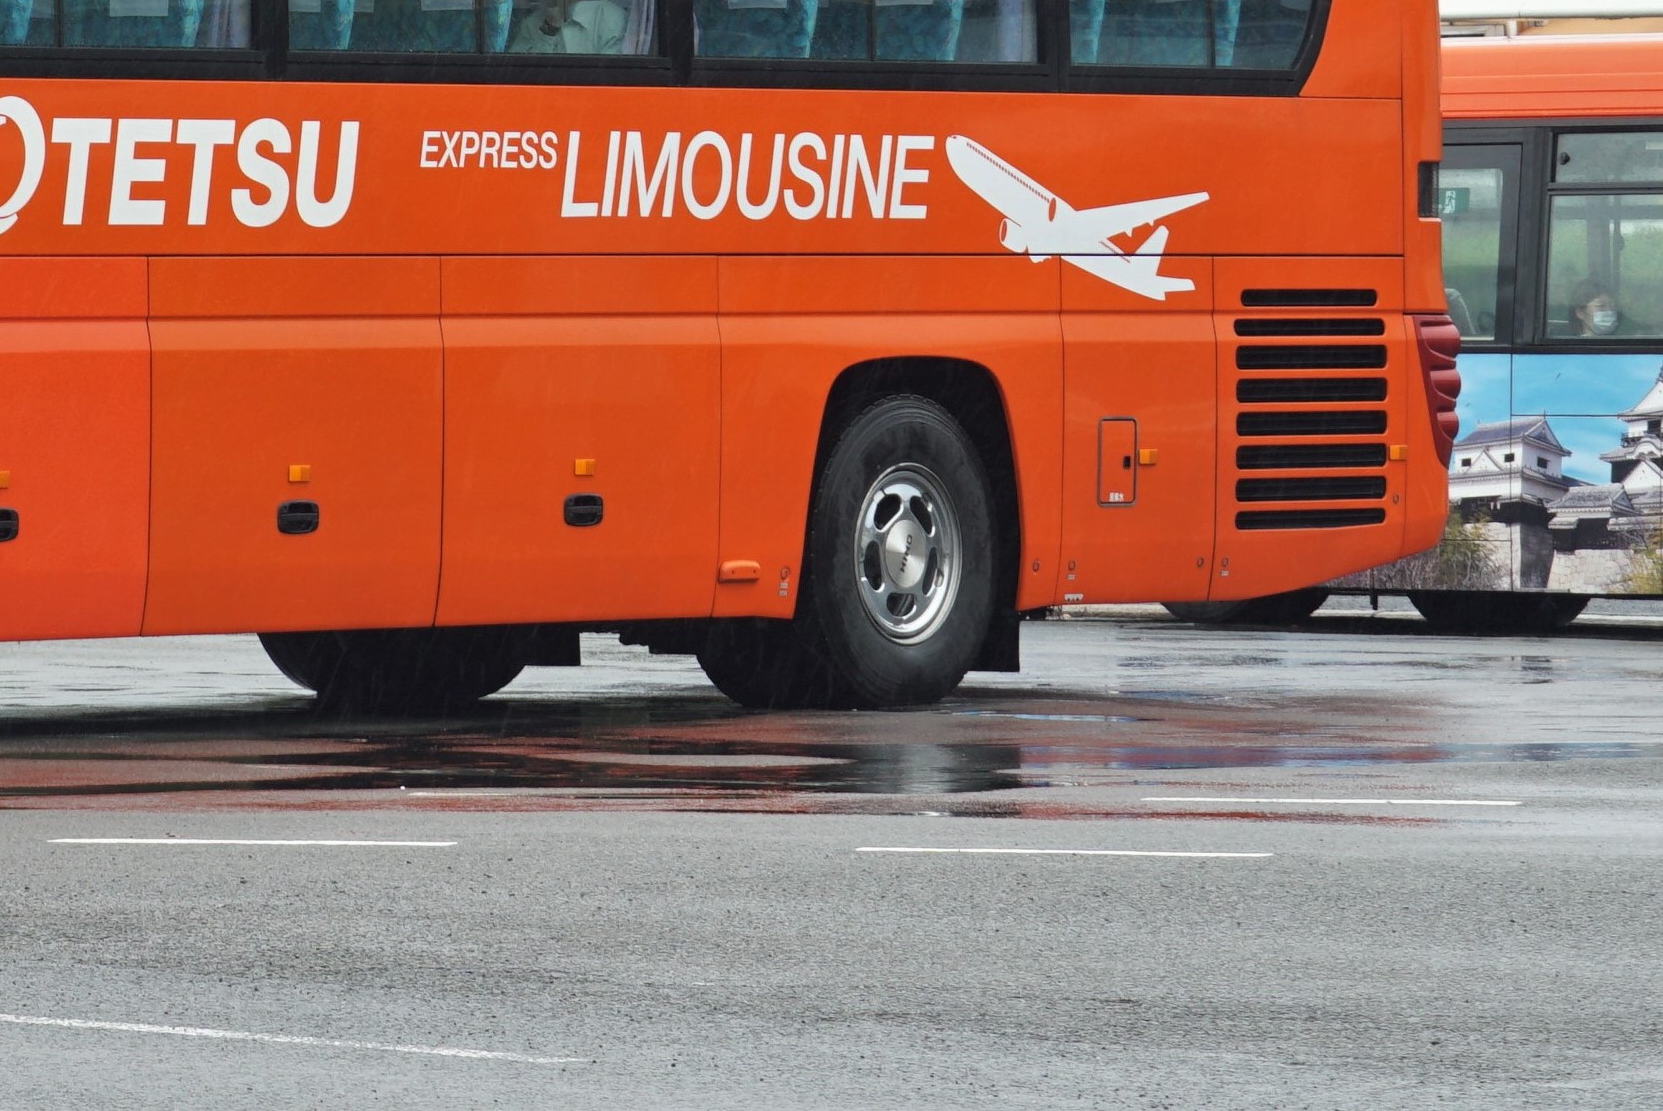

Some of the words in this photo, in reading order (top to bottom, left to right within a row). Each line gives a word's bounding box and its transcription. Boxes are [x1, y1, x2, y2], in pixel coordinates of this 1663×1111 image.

[419, 130, 558, 169] EXPRESS
[560, 130, 935, 220] LIMOUSINE
[899, 534, 913, 573] HINO
